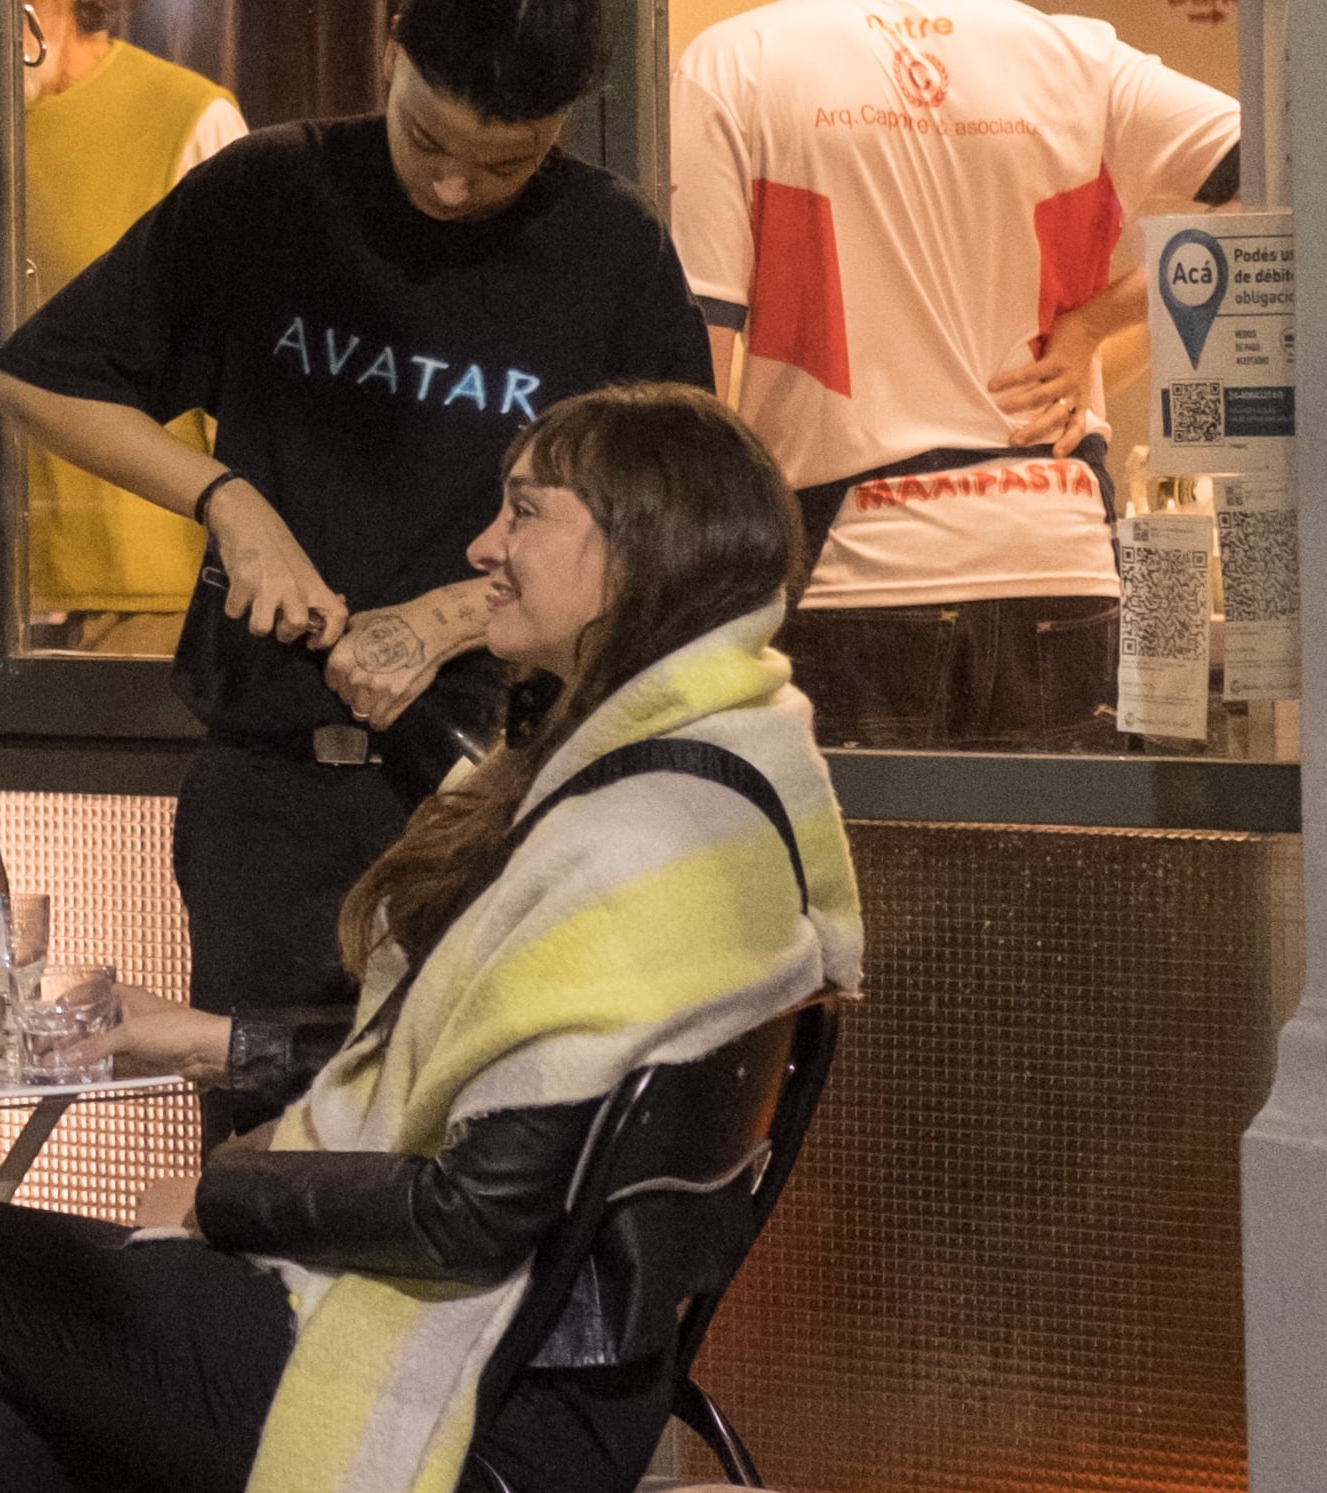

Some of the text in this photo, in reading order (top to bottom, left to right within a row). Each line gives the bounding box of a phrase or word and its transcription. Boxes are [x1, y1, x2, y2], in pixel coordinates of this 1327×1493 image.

[815, 107, 859, 128] Arq.
[1234, 247, 1277, 262] Podés
[1172, 260, 1213, 286] Acá
[1234, 270, 1251, 283] de
[273, 317, 541, 422] AVATAR
